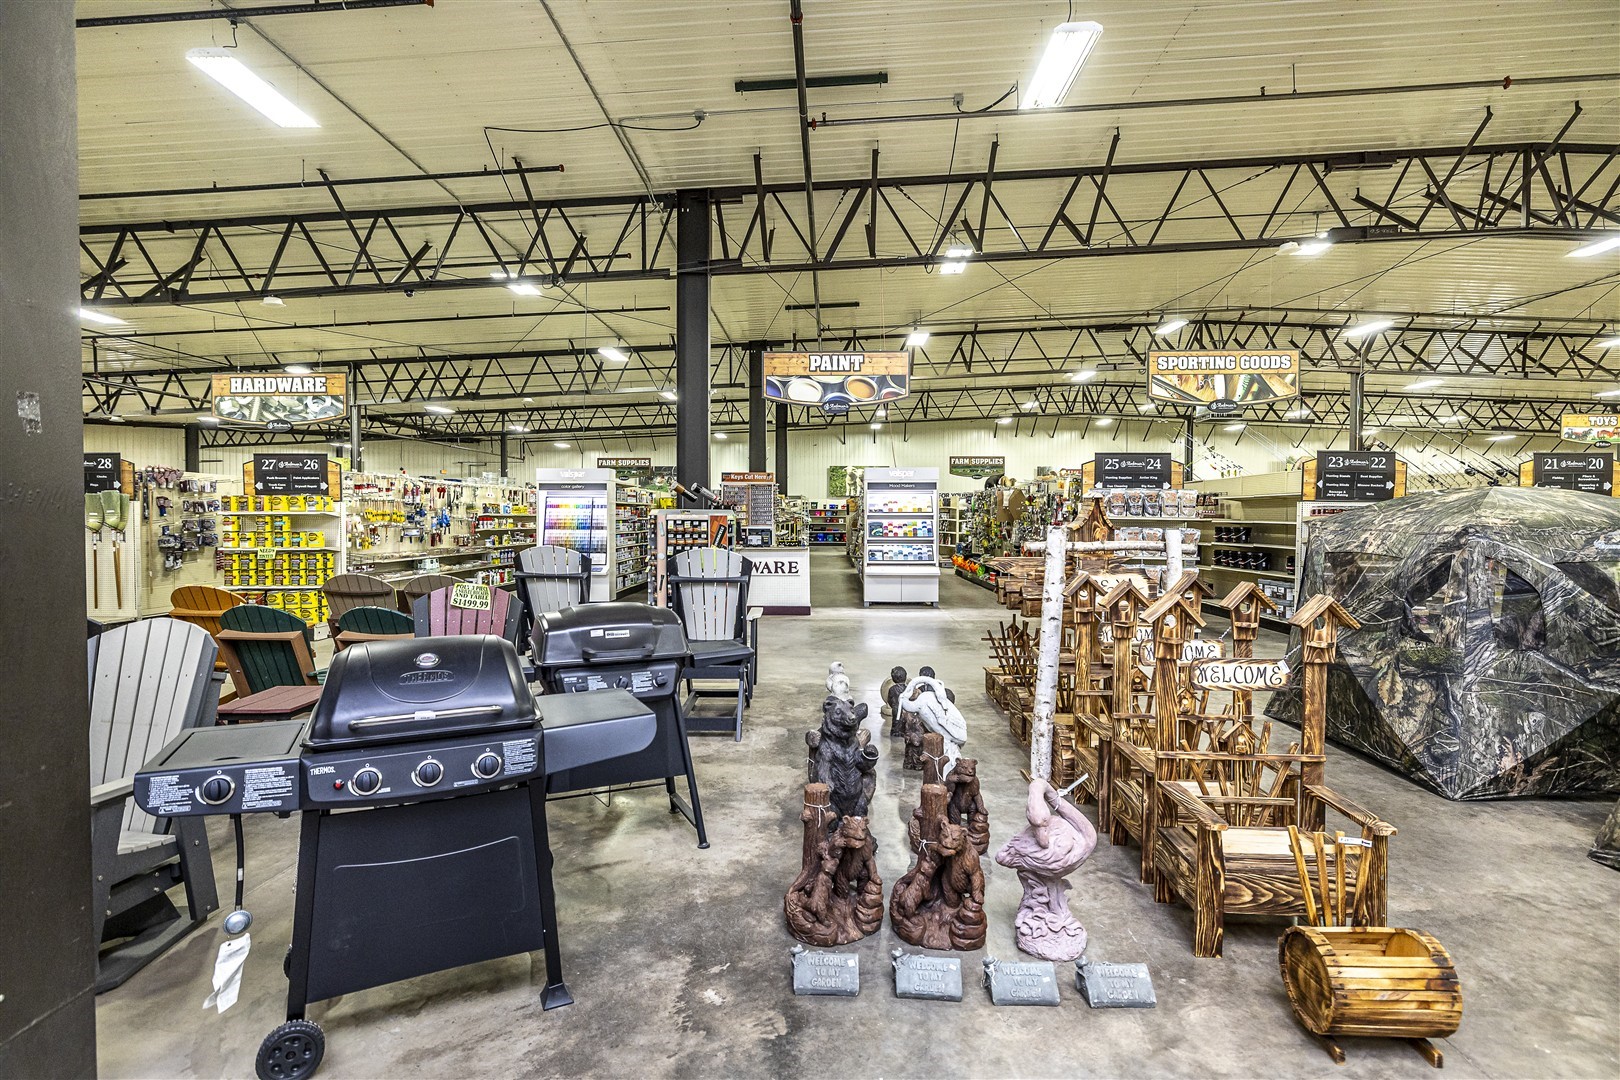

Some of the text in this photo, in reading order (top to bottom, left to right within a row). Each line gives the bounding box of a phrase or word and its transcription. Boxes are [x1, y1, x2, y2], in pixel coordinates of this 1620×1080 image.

[809, 355, 864, 372] PAINT
[1157, 355, 1291, 370] SPORTING GOODS
[230, 377, 327, 393] HARDWARE
[1589, 416, 1618, 426] TOYS
[97, 458, 112, 469] 28
[261, 459, 277, 470] 27
[303, 459, 319, 470] 26
[1104, 458, 1120, 470] 25
[1146, 458, 1161, 470] 24
[1328, 456, 1344, 468] 23
[1371, 457, 1387, 468] 22
[1544, 458, 1559, 469] 21
[1588, 458, 1604, 469] 20
[452, 598, 489, 609] $1499.99
[1196, 664, 1283, 687] WELCOME
[807, 956, 846, 967] WELCOME
[815, 966, 841, 978] TO MY
[811, 977, 842, 988] GARDEN
